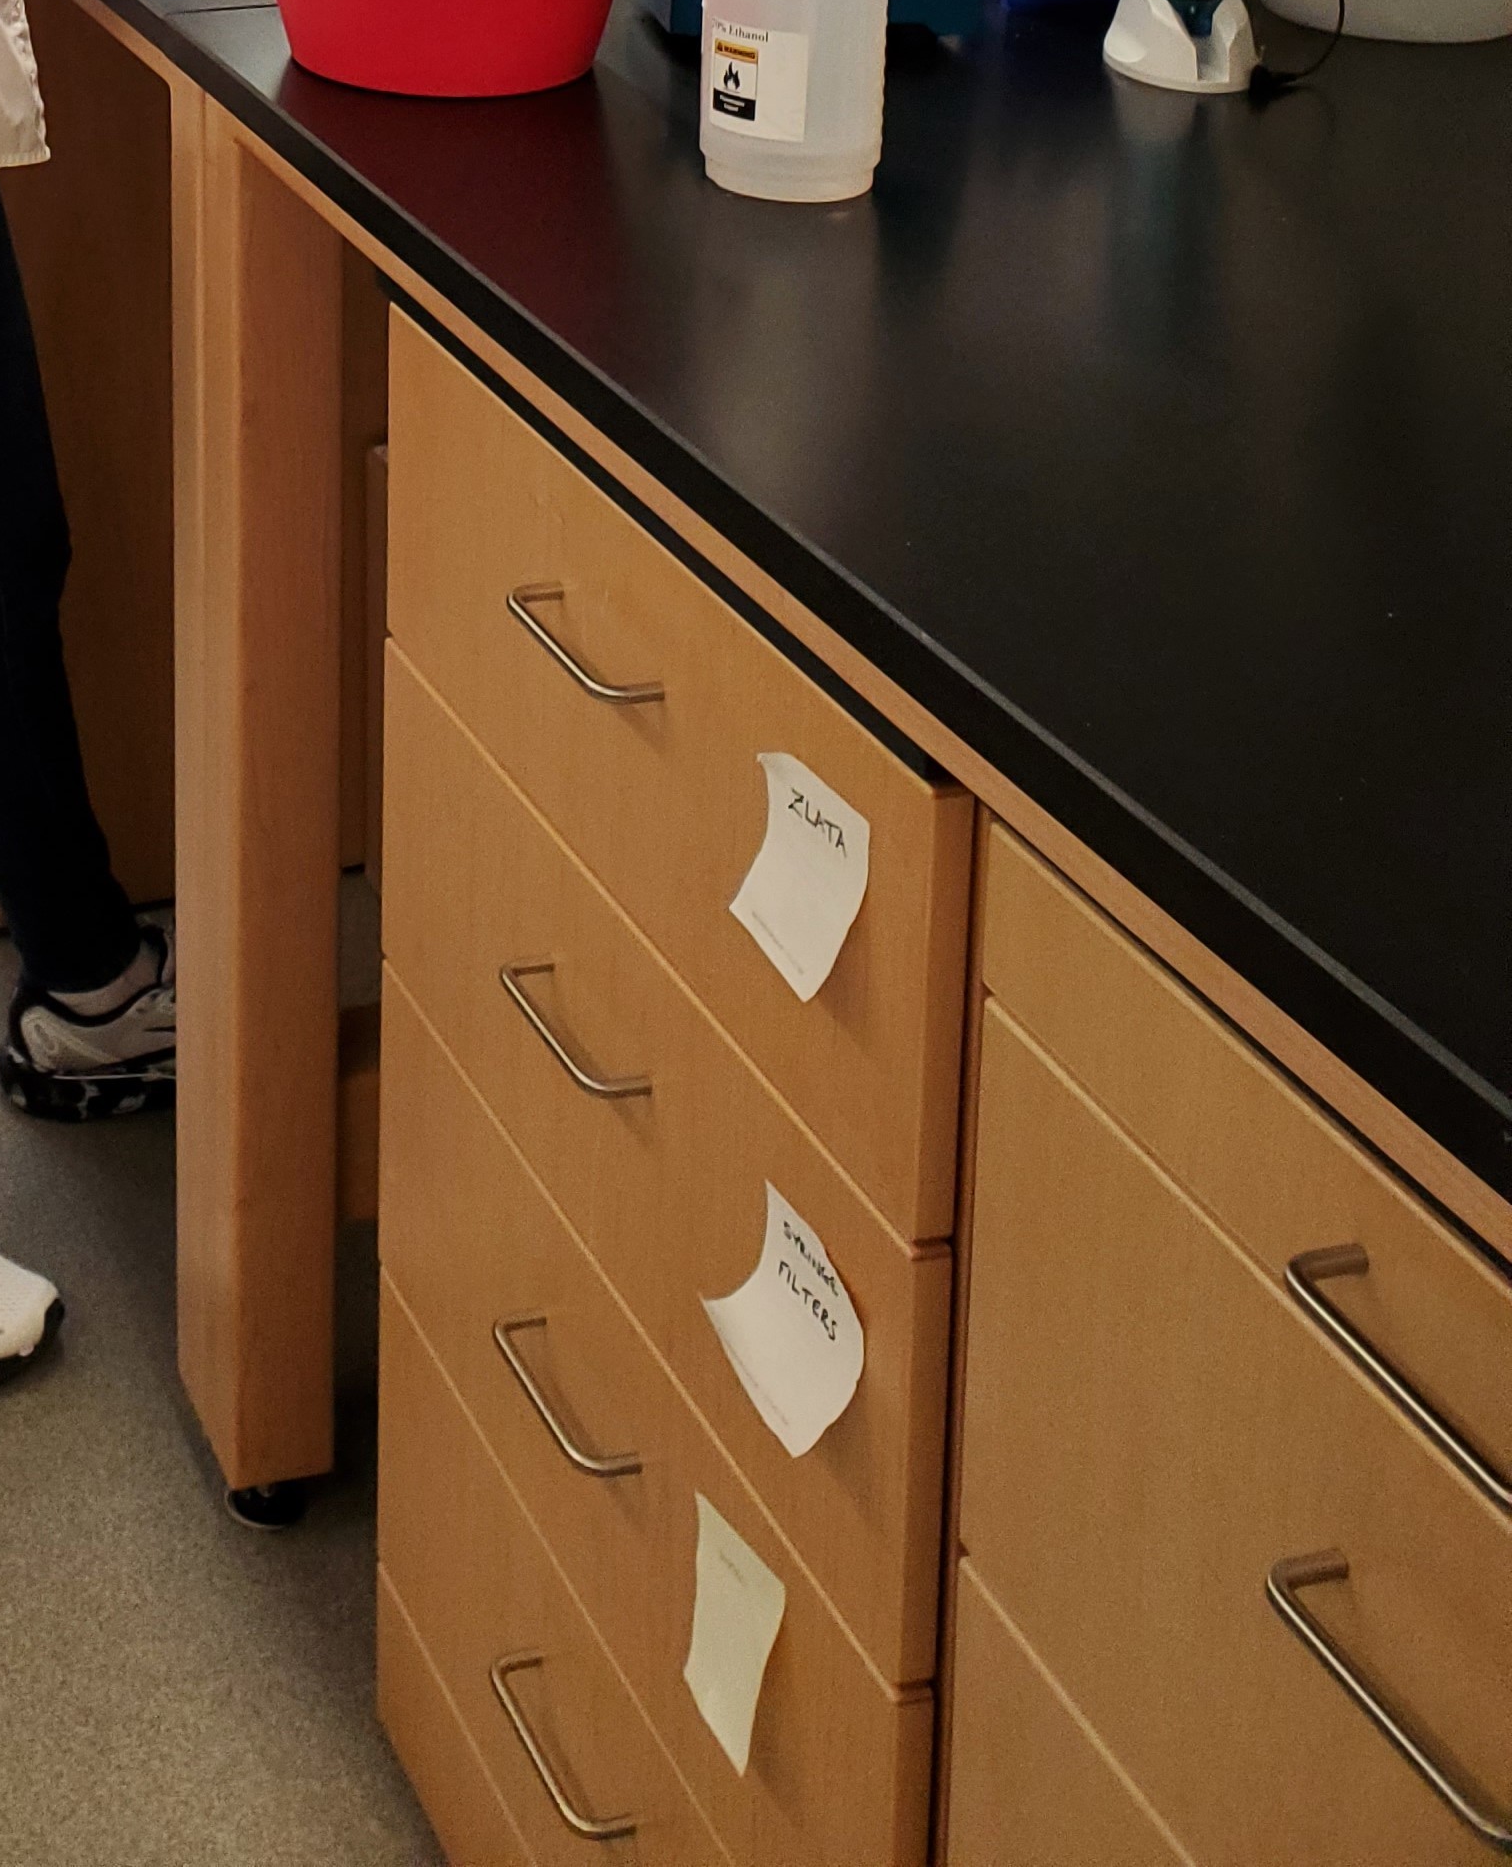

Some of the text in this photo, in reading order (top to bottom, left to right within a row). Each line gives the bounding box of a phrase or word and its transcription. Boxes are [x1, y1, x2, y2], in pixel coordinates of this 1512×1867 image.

[729, 24, 769, 43] Ethanol
[787, 787, 847, 859] ZLATA
[777, 1260, 838, 1342] FILTERS
